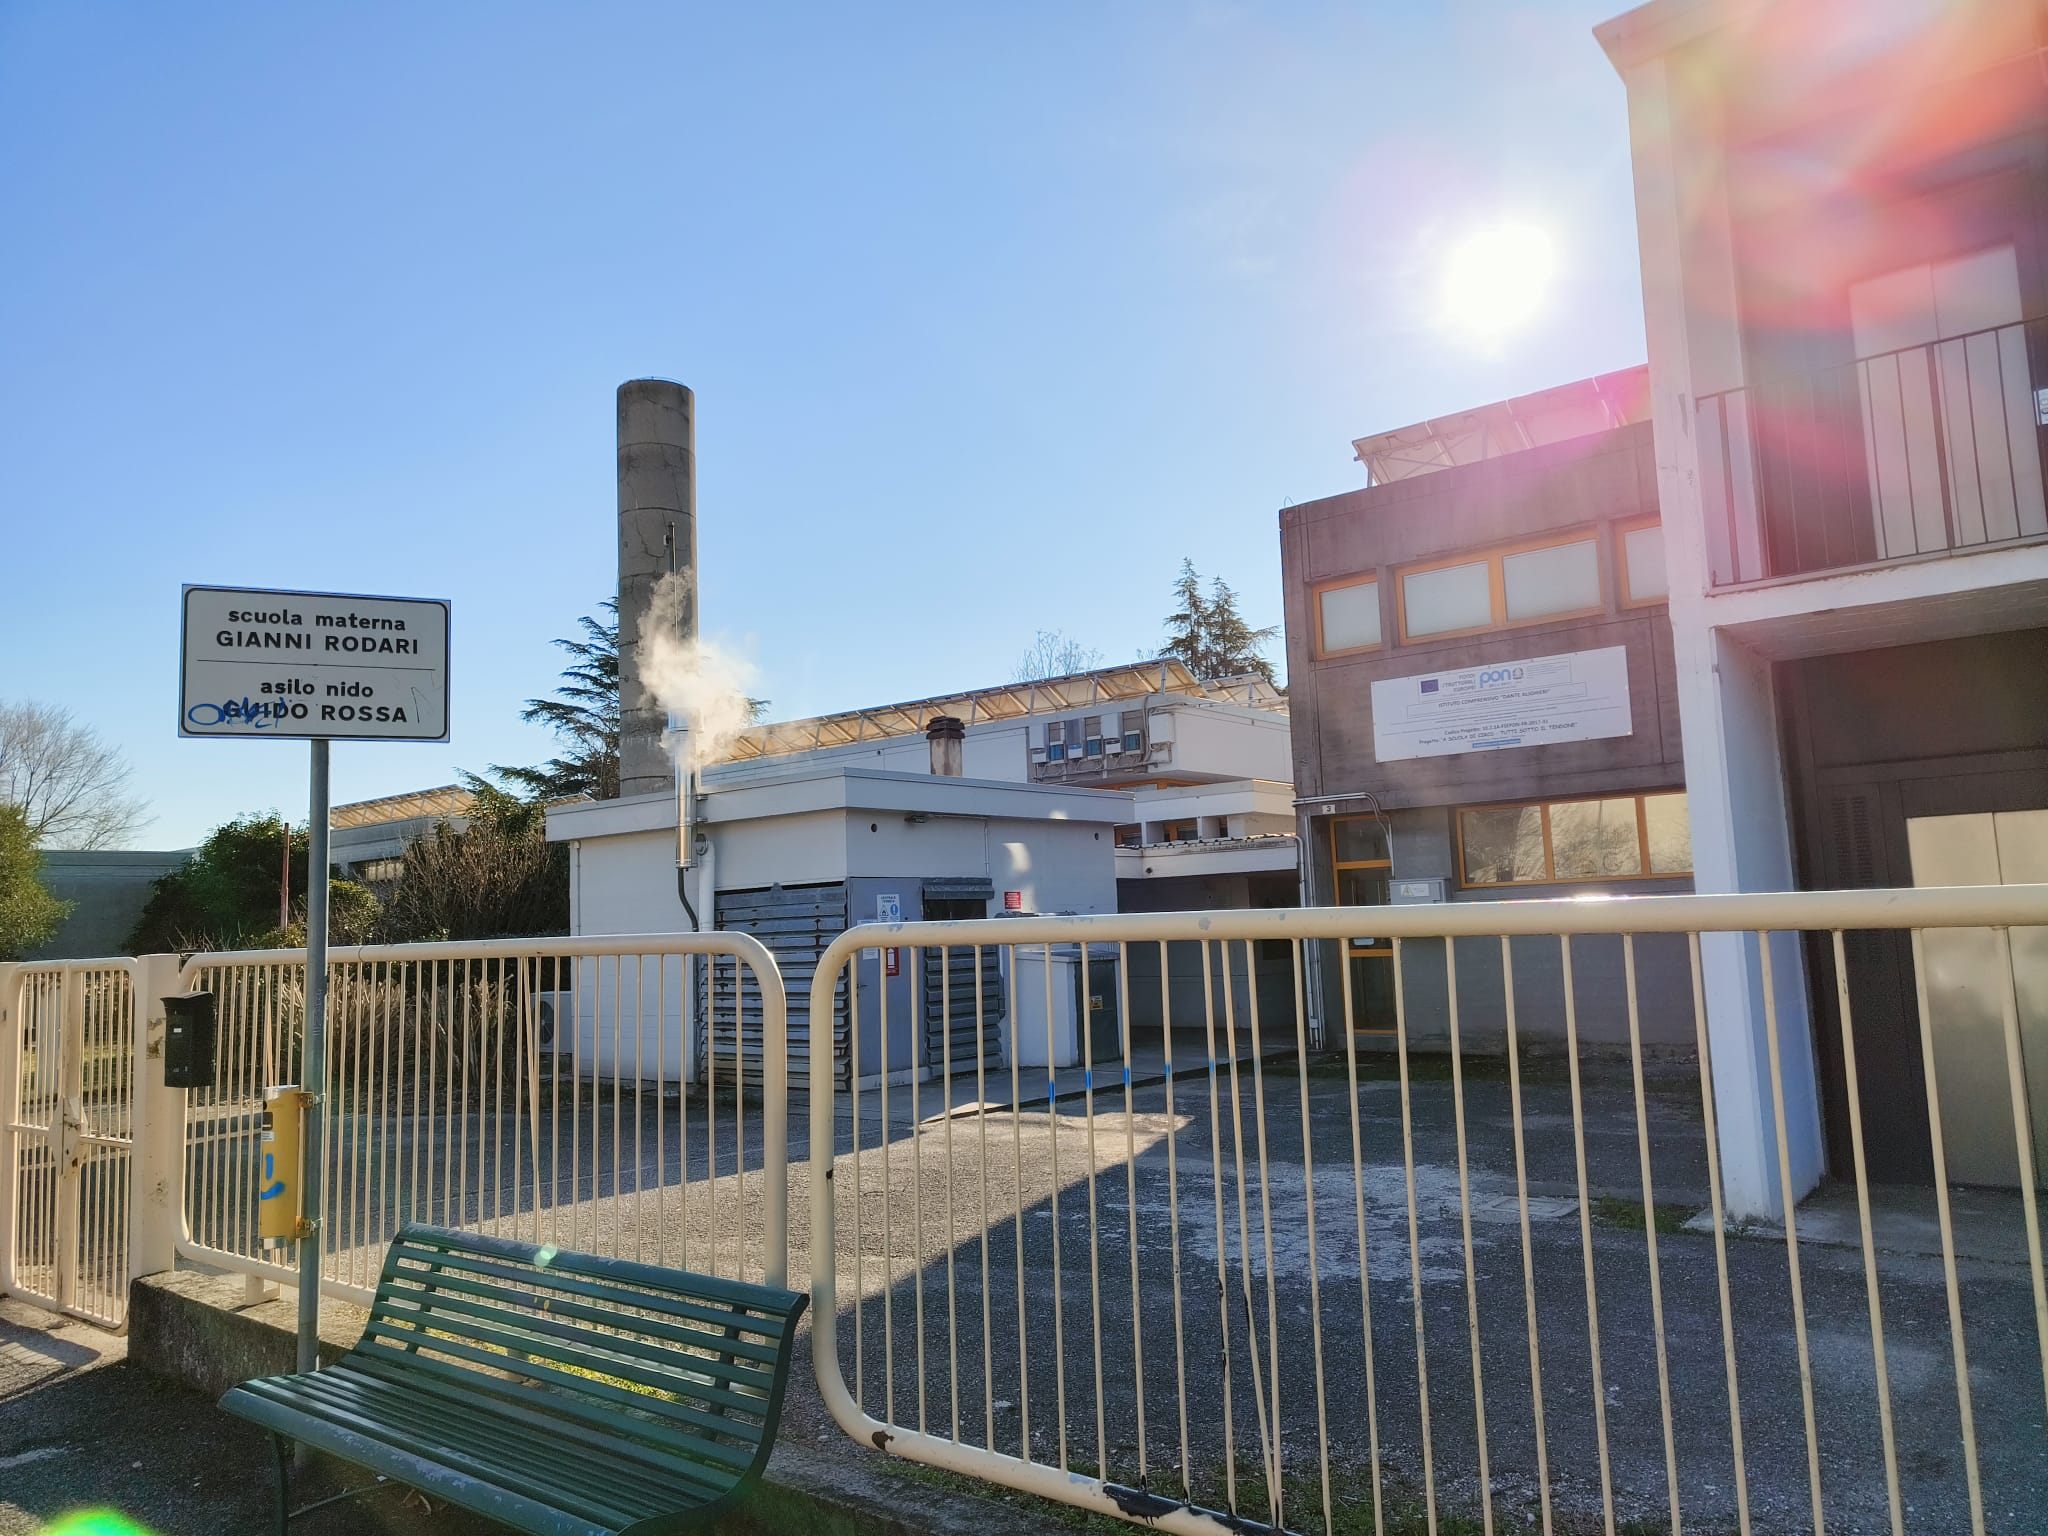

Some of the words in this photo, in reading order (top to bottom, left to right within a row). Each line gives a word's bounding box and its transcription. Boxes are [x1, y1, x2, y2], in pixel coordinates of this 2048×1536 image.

[228, 608, 303, 626] scuola
[315, 612, 406, 631] materna
[216, 630, 311, 649] GIANNI
[325, 635, 418, 654] RODARI
[260, 678, 315, 696] asilo
[326, 681, 374, 698] nido
[1480, 668, 1511, 688] pon
[320, 704, 408, 723] ROSSA
